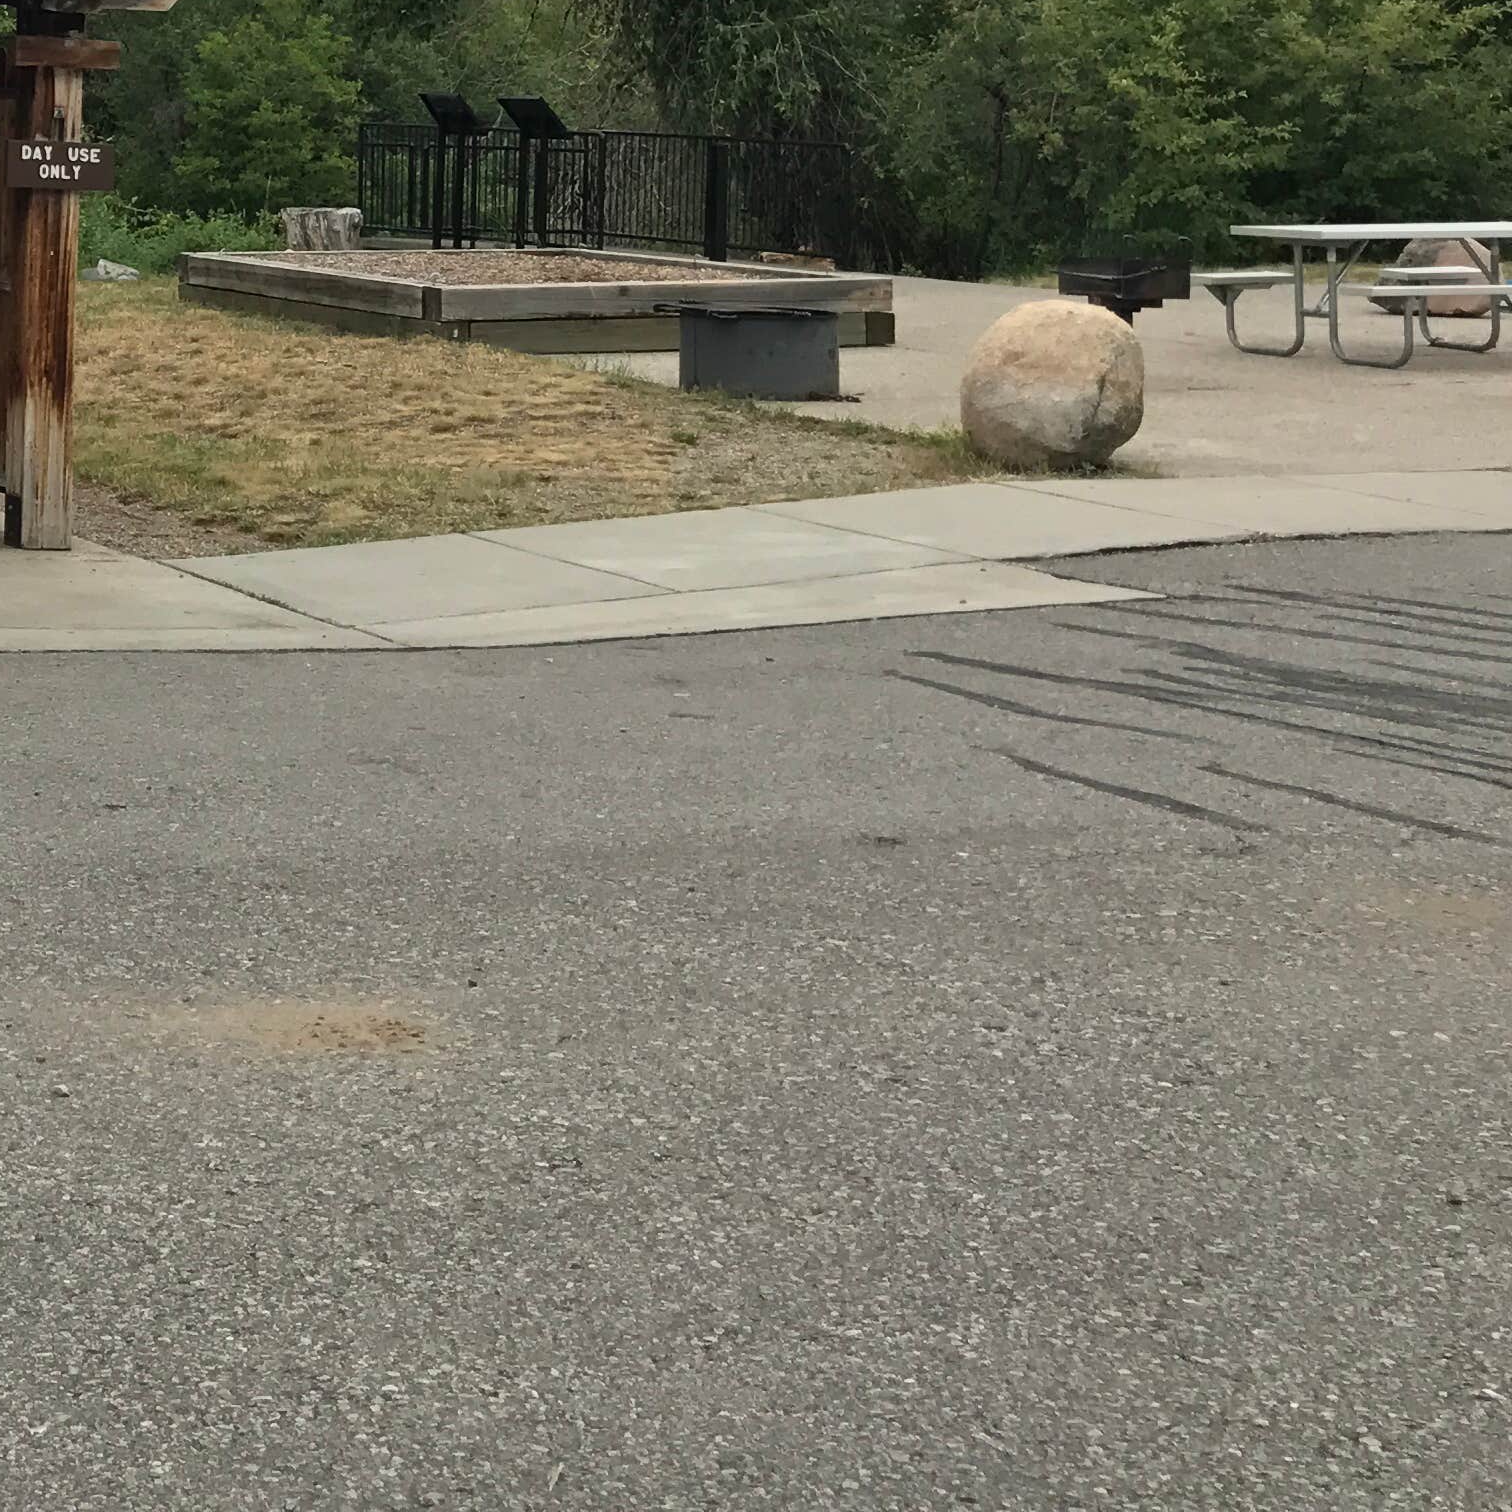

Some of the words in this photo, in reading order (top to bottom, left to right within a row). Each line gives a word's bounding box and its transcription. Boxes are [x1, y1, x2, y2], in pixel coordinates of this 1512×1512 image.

[21, 144, 53, 161] DAY
[68, 147, 101, 163] USE
[39, 164, 81, 180] ONLY
